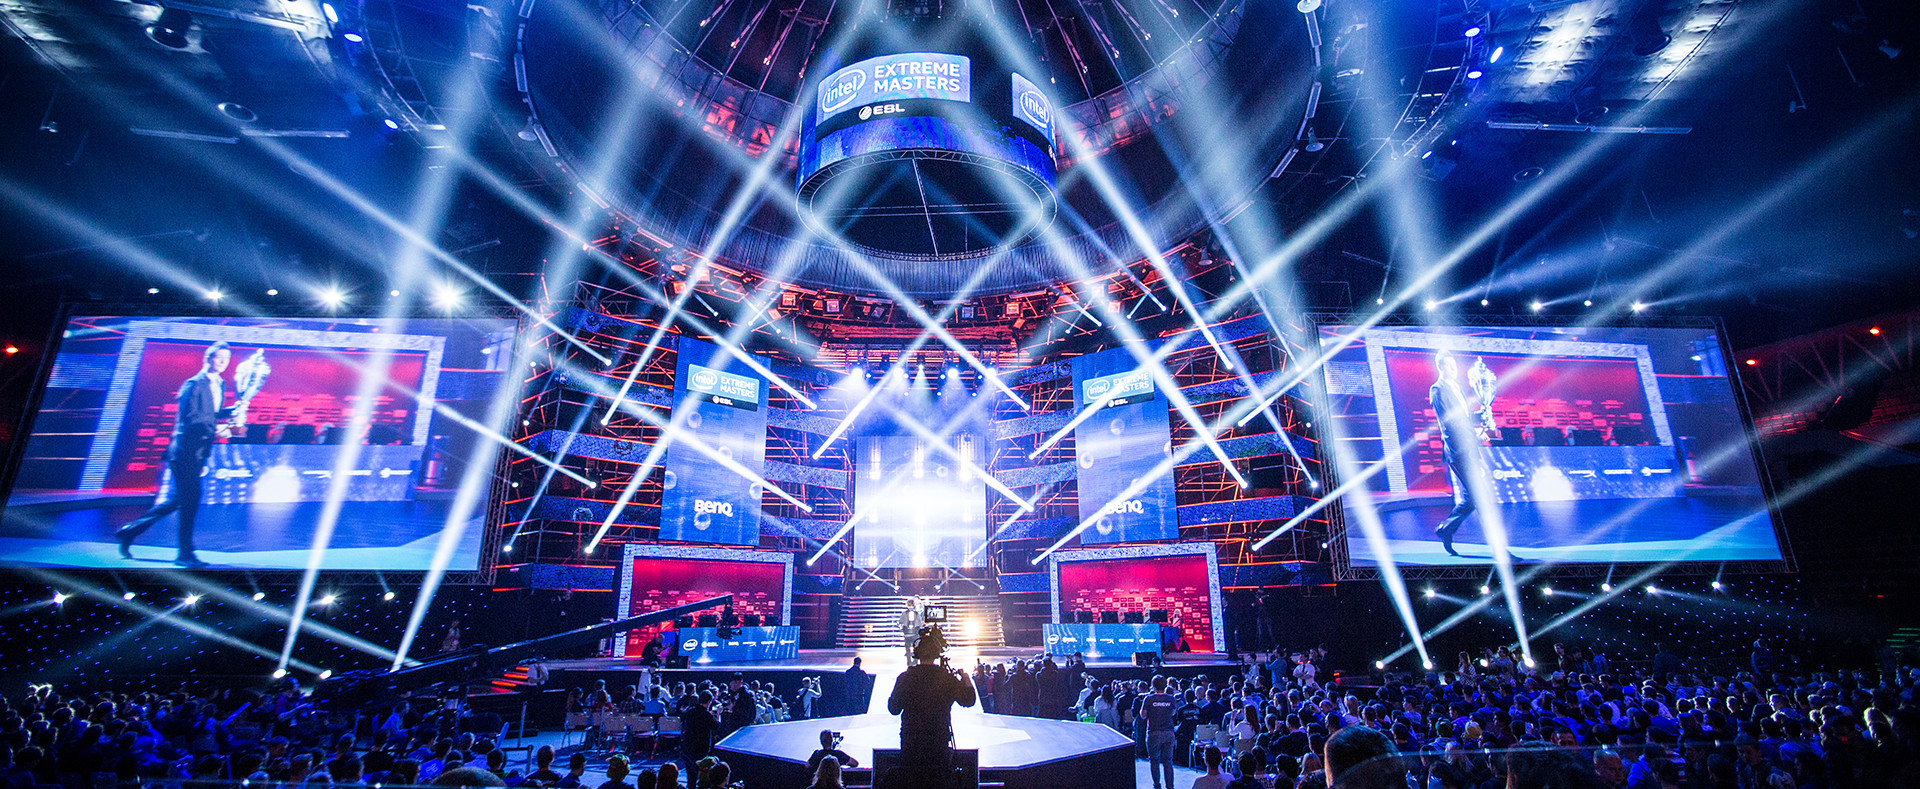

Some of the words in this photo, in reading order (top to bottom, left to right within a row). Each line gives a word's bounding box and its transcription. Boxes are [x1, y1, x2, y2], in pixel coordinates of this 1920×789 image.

[874, 61, 961, 79] EXTREME
[825, 74, 859, 104] intel
[873, 75, 961, 94] MASTERS
[872, 103, 906, 116] ESL
[1023, 91, 1047, 123] intel
[694, 372, 715, 386] intel
[720, 376, 756, 391] EXTREME
[1112, 372, 1149, 386] EXTREME
[719, 384, 755, 398] MASTERS
[1089, 381, 1108, 395] intel
[694, 499, 734, 518] BenQ
[1105, 499, 1144, 515] BenQ
